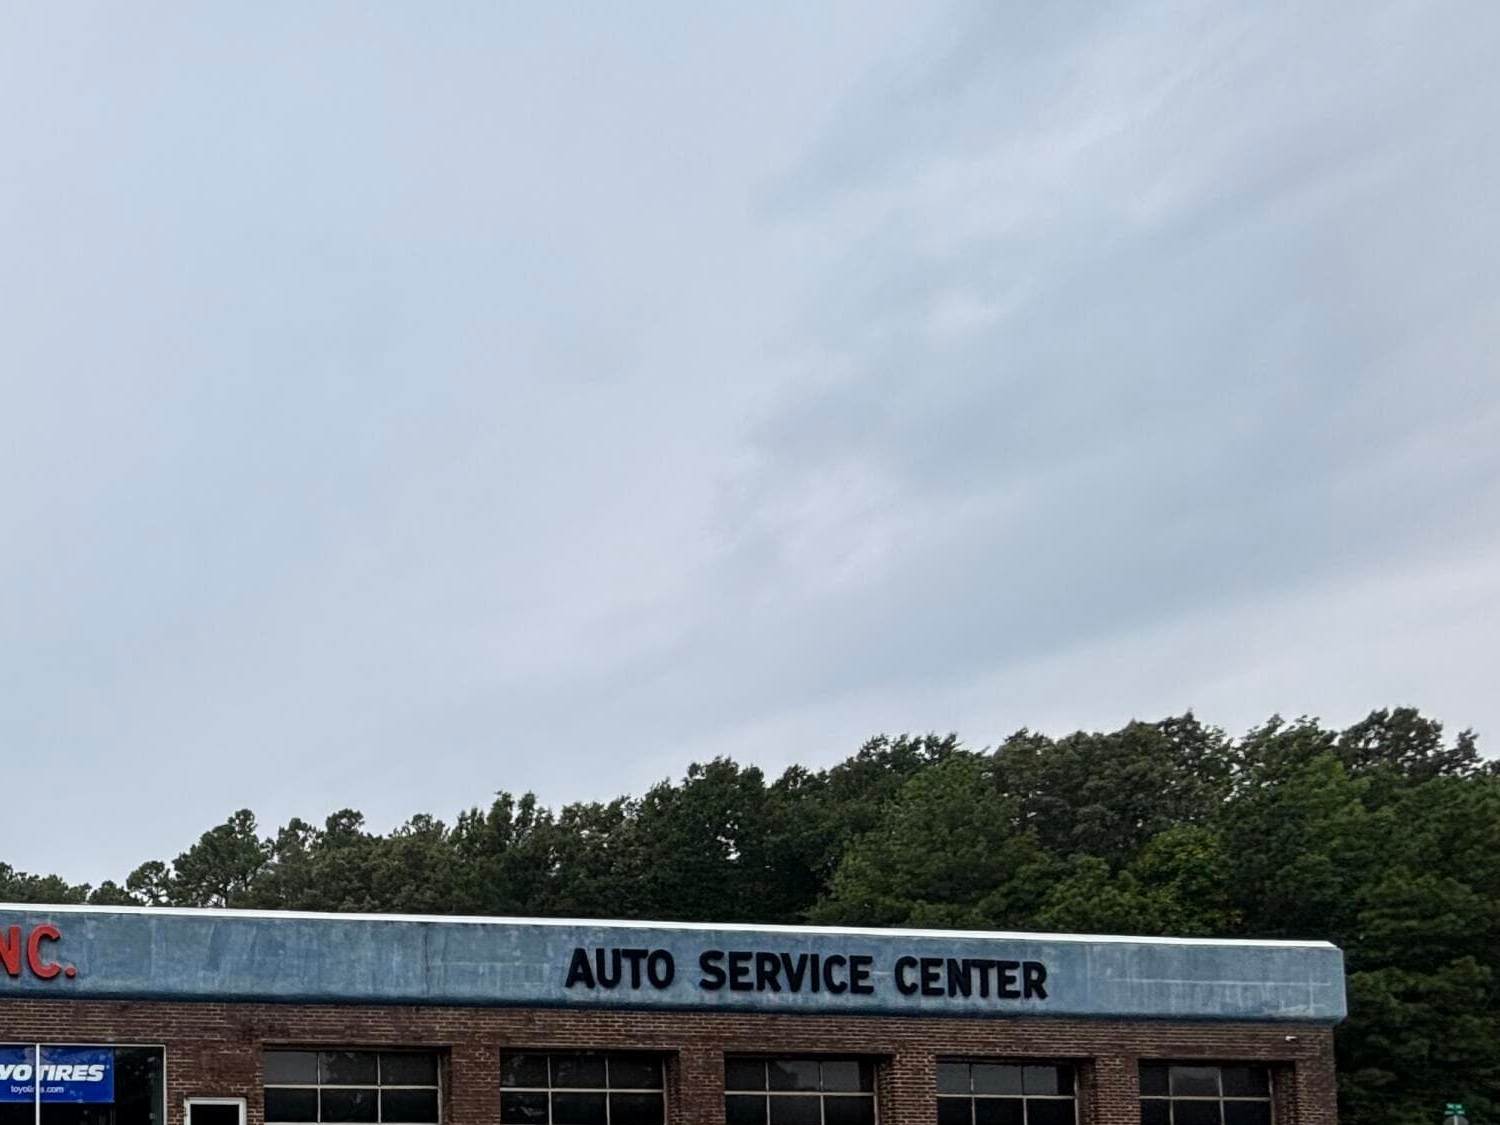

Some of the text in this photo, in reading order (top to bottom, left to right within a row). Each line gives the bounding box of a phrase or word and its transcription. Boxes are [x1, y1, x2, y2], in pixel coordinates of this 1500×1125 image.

[565, 947, 1049, 1000] AUTO SERVICE CENTER
[38, 1064, 105, 1082] TIRES
